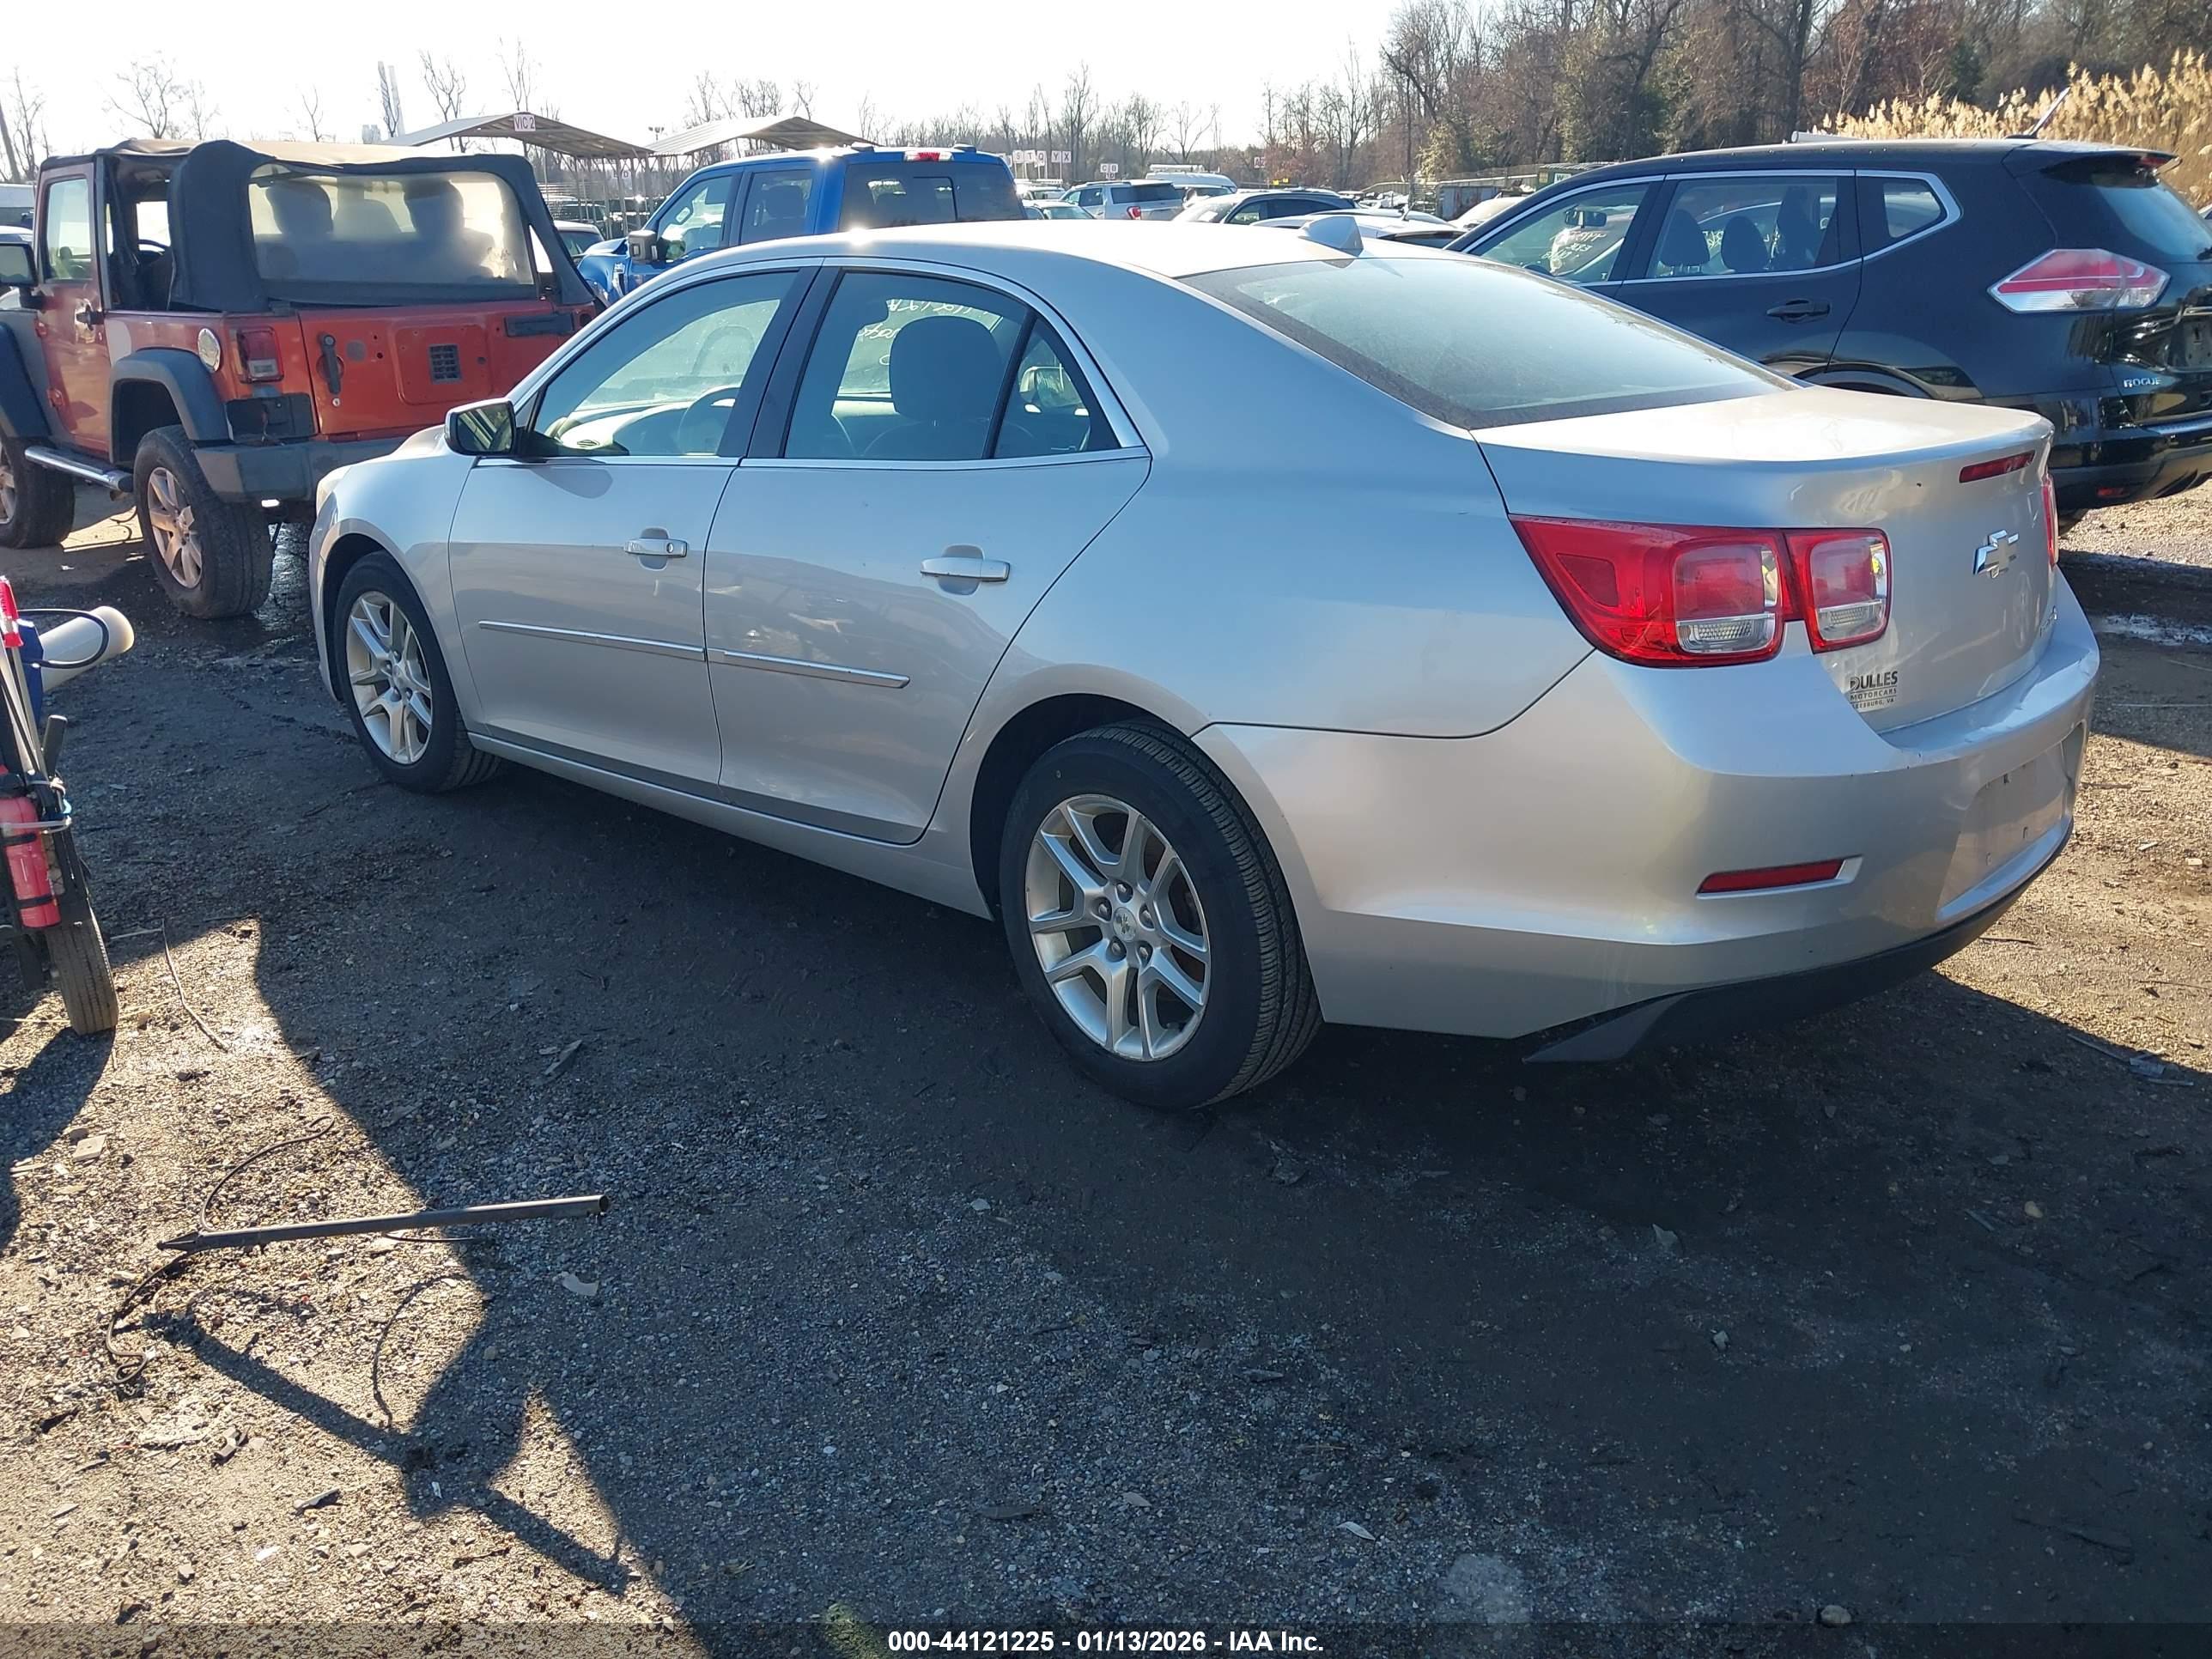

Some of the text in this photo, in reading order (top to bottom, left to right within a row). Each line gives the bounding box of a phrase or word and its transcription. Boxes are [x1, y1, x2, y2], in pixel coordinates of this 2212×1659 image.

[514, 116, 535, 129] VIC 2
[2123, 378, 2160, 387] ROGUE
[1850, 671, 1898, 691] DULLES
[1850, 688, 1897, 701] MOTORCARS
